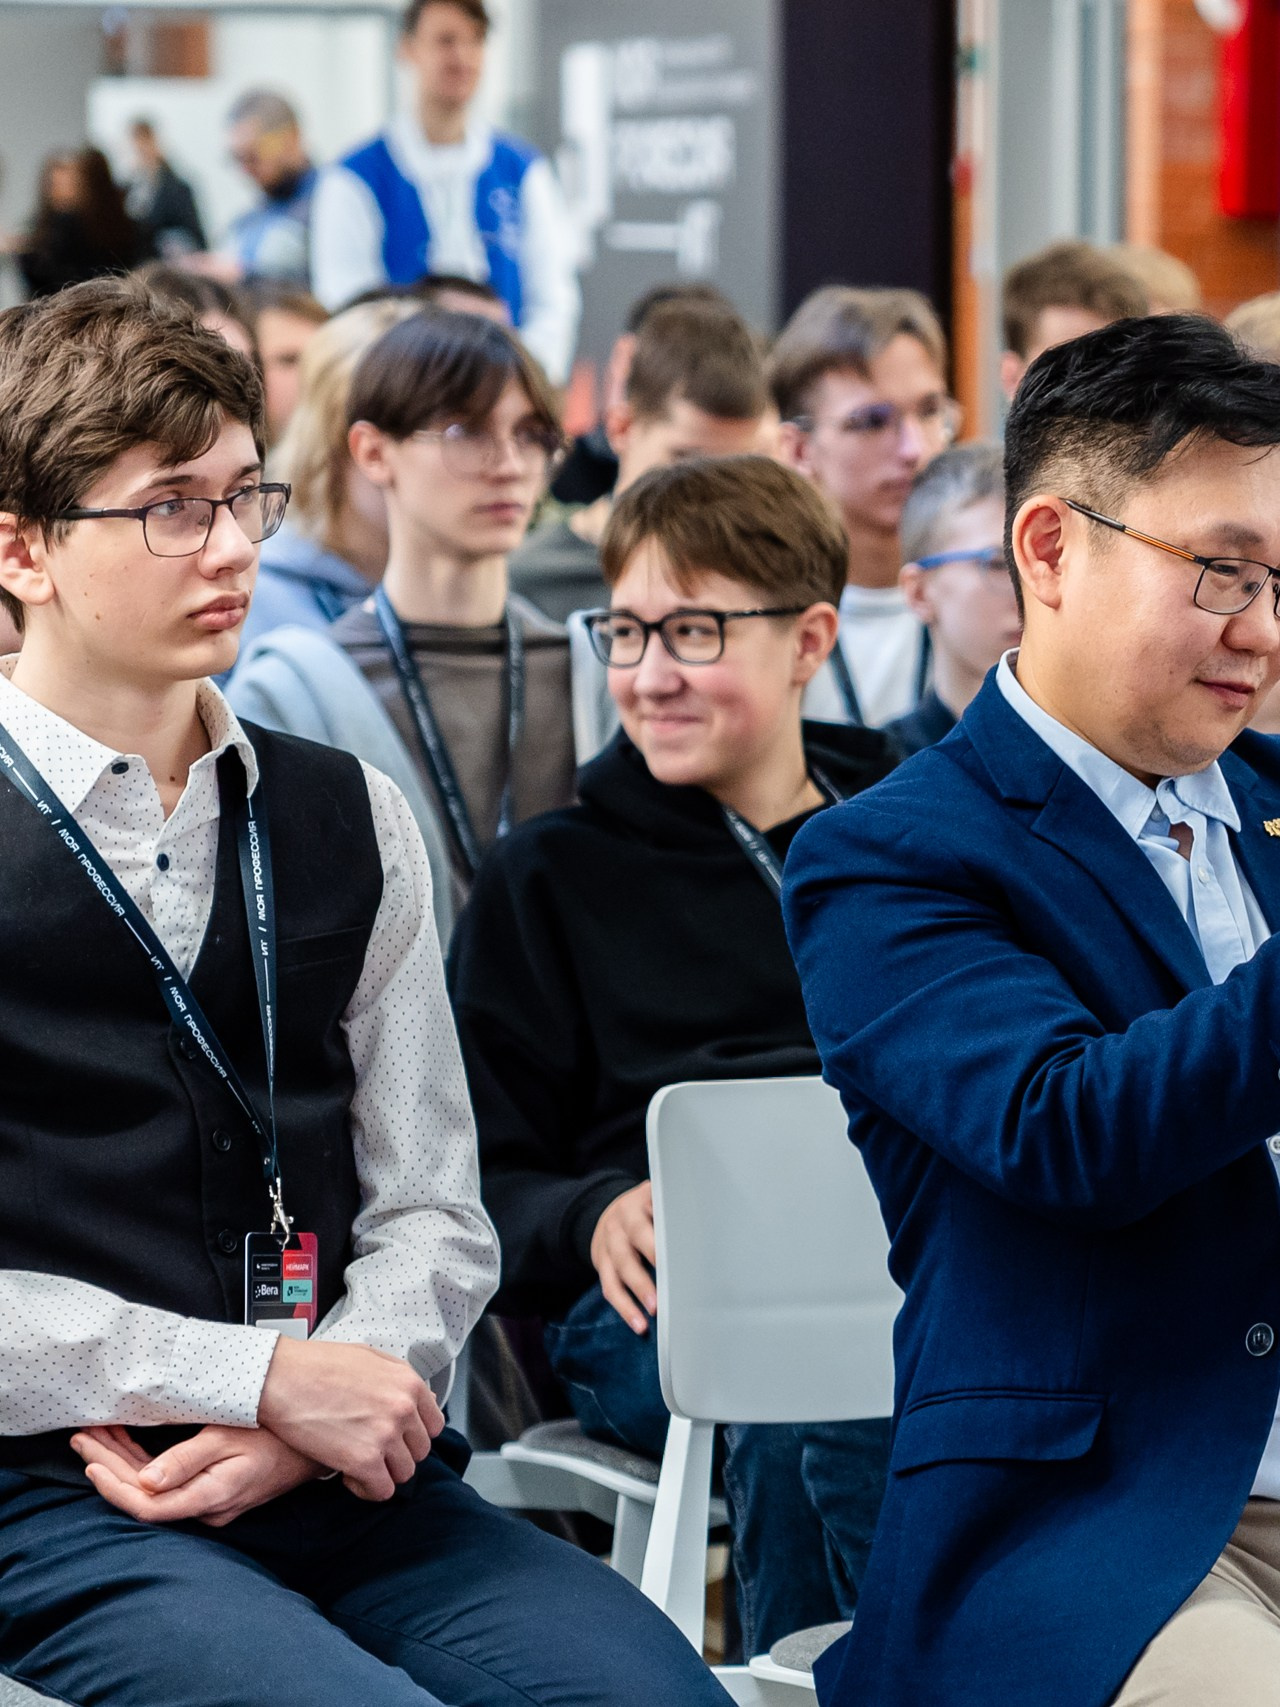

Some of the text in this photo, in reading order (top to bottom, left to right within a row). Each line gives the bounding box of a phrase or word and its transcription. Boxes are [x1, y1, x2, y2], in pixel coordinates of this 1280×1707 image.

[36, 800, 52, 815] ИТ
[58, 828, 80, 853] МОЯ
[77, 853, 126, 917] ПРОФЕССИЯ
[248, 820, 264, 890] ПРОФЕССИЯ
[256, 894, 266, 921] МОЯ
[260, 939, 268, 956] ИТ
[150, 956, 165, 970] ИТ
[170, 986, 187, 1013] МОЯ
[183, 1014, 228, 1079] ПРОФЕССИЯ
